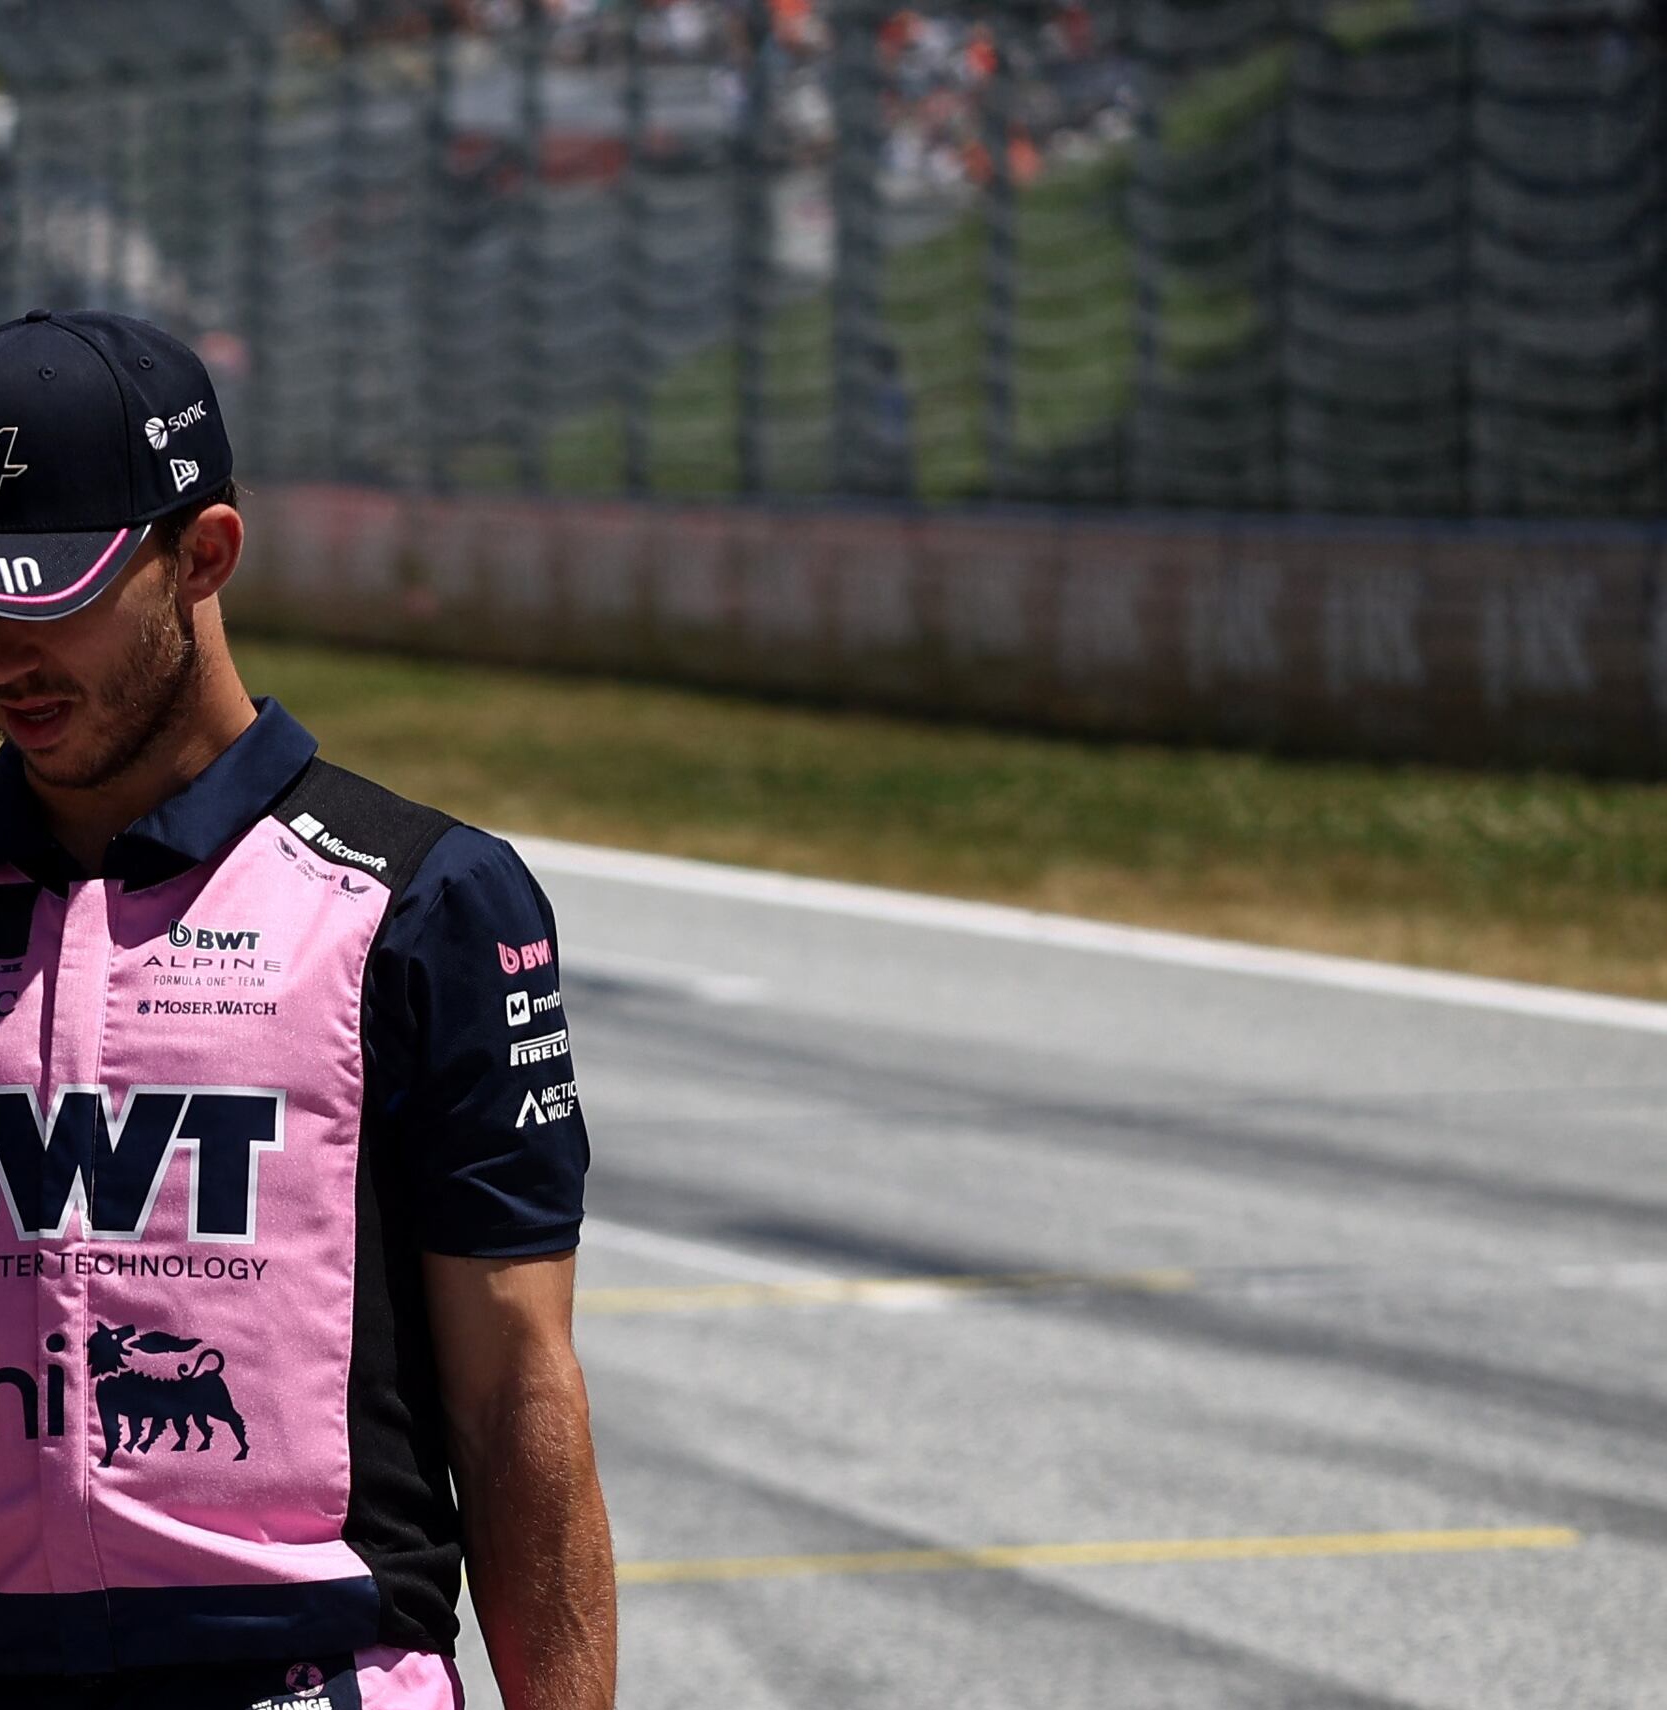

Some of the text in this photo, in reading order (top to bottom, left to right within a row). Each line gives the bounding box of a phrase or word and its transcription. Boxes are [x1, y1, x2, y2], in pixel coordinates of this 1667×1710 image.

[316, 832, 387, 872] Microsoft
[196, 928, 261, 950] BWT
[142, 955, 282, 972] ALPINE
[153, 974, 202, 987] FORMULA
[238, 977, 265, 987] TEAM
[547, 1100, 575, 1123] WOLF
[55, 1252, 269, 1281] TECHNOLOGY
